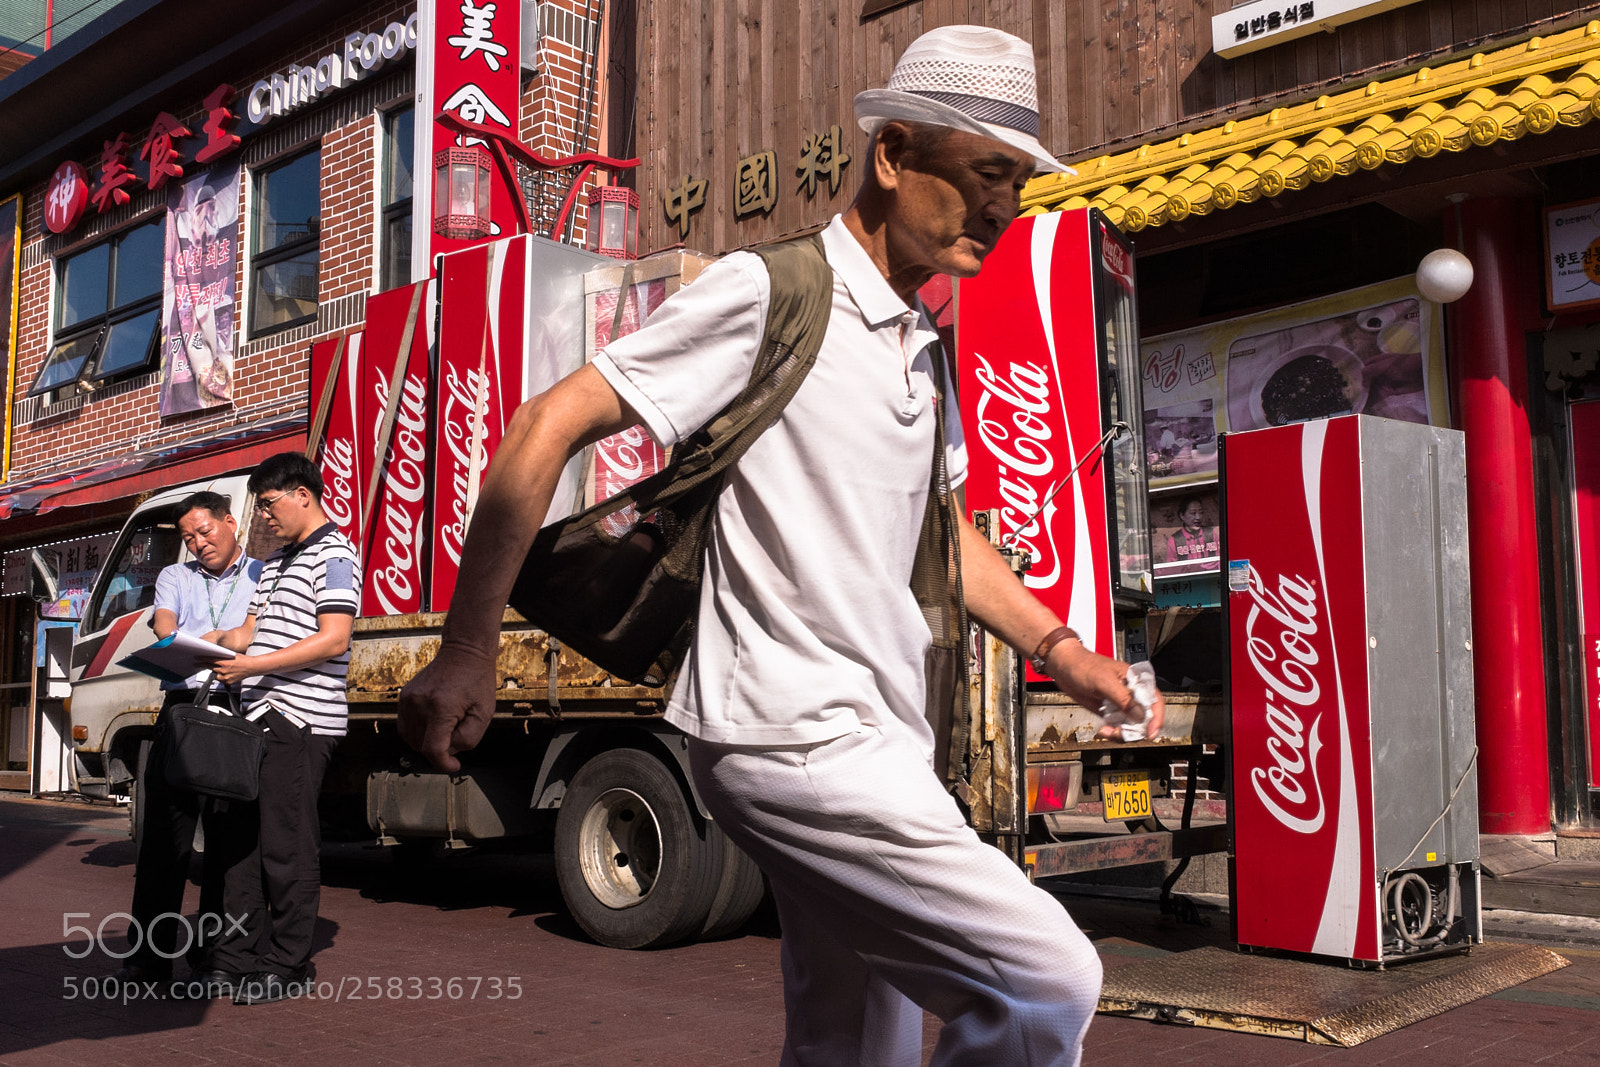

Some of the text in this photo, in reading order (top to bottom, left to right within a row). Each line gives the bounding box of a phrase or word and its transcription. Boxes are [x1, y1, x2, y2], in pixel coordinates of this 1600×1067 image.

[1233, 1, 1315, 42] 일반음식점
[247, 55, 343, 125] China
[176, 238, 231, 276] 인천 최초
[318, 433, 353, 527] -Cola
[373, 366, 428, 615] Coca-Cola
[1246, 564, 1326, 834] Coca-Cola
[1126, 773, 1137, 786] 82
